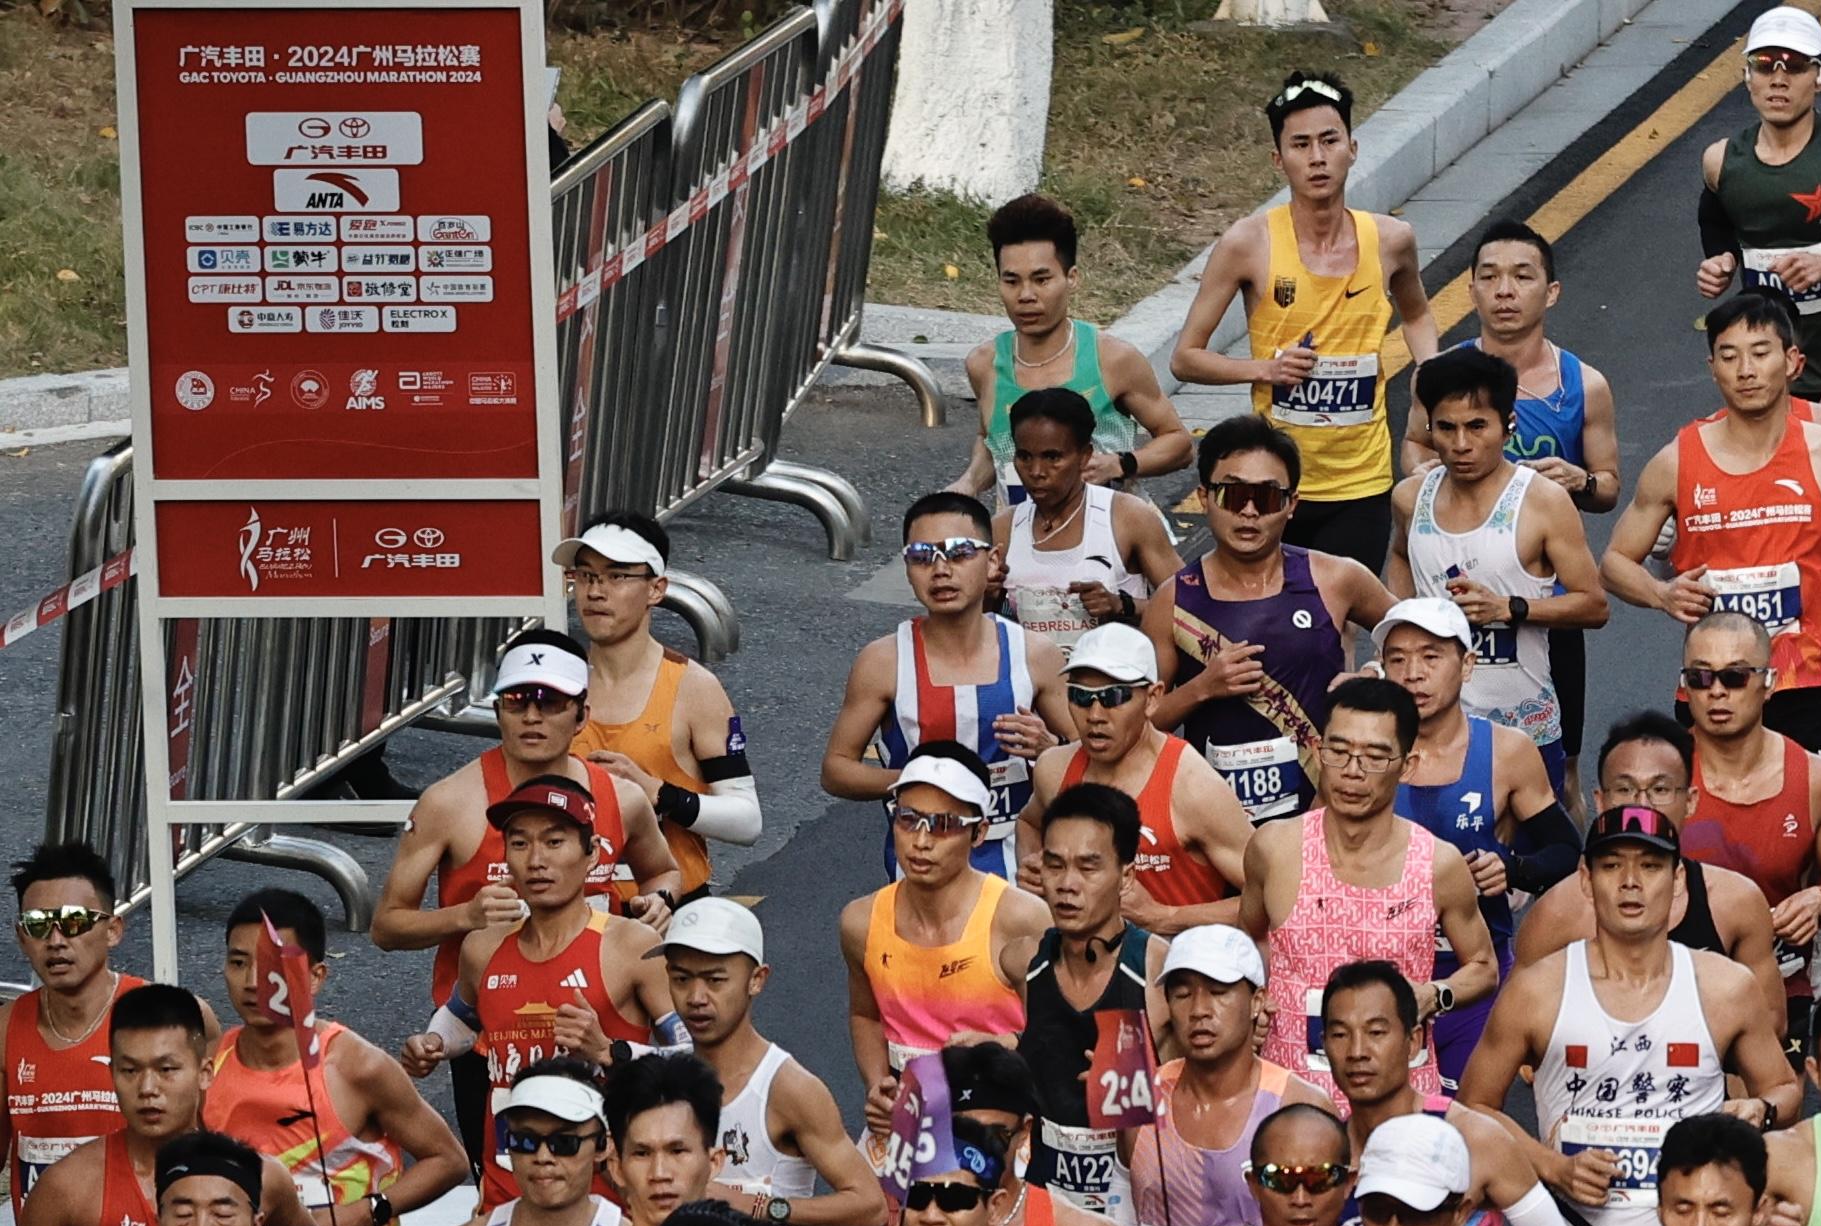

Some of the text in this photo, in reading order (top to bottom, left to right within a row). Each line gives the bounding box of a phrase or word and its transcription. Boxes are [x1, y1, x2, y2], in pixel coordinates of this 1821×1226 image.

[179, 46, 481, 68] 广汽丰田 2024广州马拉松赛
[179, 71, 482, 86] GAC TOYOTA GUANGZHOU MARATHON 2024
[283, 145, 388, 160] 广汽丰田
[305, 192, 344, 208] ANTA
[293, 221, 332, 236] 易方达
[273, 280, 295, 292] JDL
[390, 310, 448, 319] ELECTRO X
[1287, 378, 1360, 406] A0471
[346, 396, 386, 410] AIMS
[360, 553, 460, 568] 广汽丰田
[1712, 592, 1783, 622] A1951
[1022, 619, 1099, 633] GEBRESLAS
[1610, 1034, 1653, 1056] 江西
[1565, 1072, 1693, 1105] 中国警察
[1634, 1108, 1686, 1119] POLICE
[1056, 1154, 1114, 1185] A122
